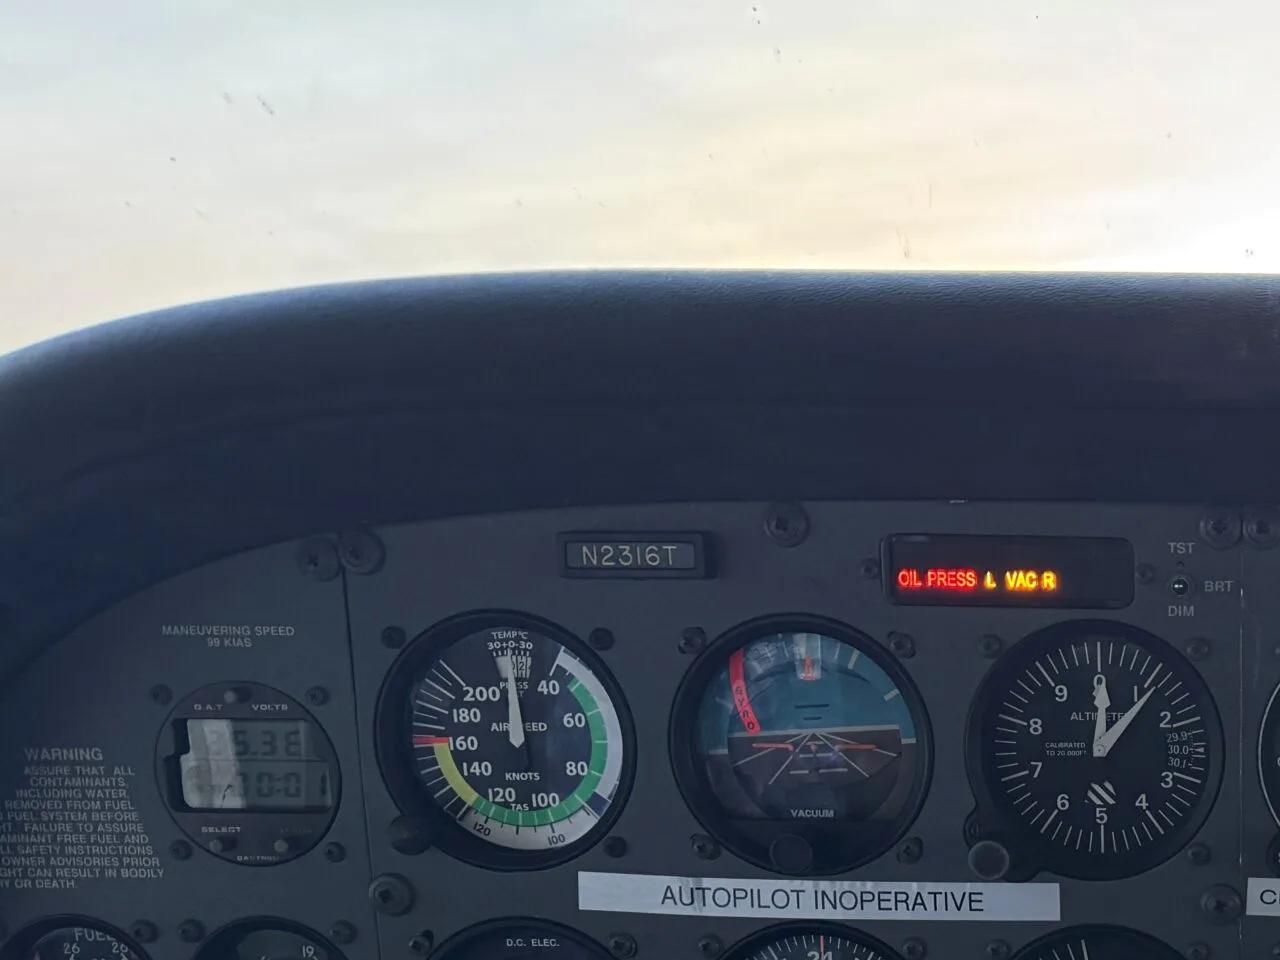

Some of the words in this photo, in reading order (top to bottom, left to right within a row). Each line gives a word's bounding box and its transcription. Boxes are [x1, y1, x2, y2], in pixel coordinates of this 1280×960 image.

[1168, 543, 1194, 554] TST
[582, 546, 677, 565] N2316T
[898, 570, 923, 587] OIL
[927, 570, 977, 588] PRESS
[984, 572, 996, 588] L
[1005, 572, 1039, 588] VAC
[1042, 572, 1057, 588] R
[1205, 581, 1233, 593] BRT
[1168, 606, 1194, 617] DIM
[162, 626, 251, 636] MANEUVERING
[255, 626, 295, 636] SPEED
[208, 638, 220, 647] 99
[224, 638, 252, 648] KIAS
[463, 686, 500, 701] 200
[538, 680, 560, 696] 40
[453, 708, 481, 723] 180
[563, 713, 585, 729] 60
[25, 748, 103, 761] WARNING
[24, 766, 72, 776] ASSURE
[75, 766, 104, 776] THAT
[113, 766, 135, 776] ALL
[566, 762, 588, 776] 80
[505, 772, 540, 782] KNOTS
[791, 809, 834, 818] VACUUM
[662, 886, 806, 911] AUTOPILOT
[814, 889, 984, 913] INOPERATIVE
[506, 938, 527, 948] D.C.
[531, 938, 560, 948] ELEC.
